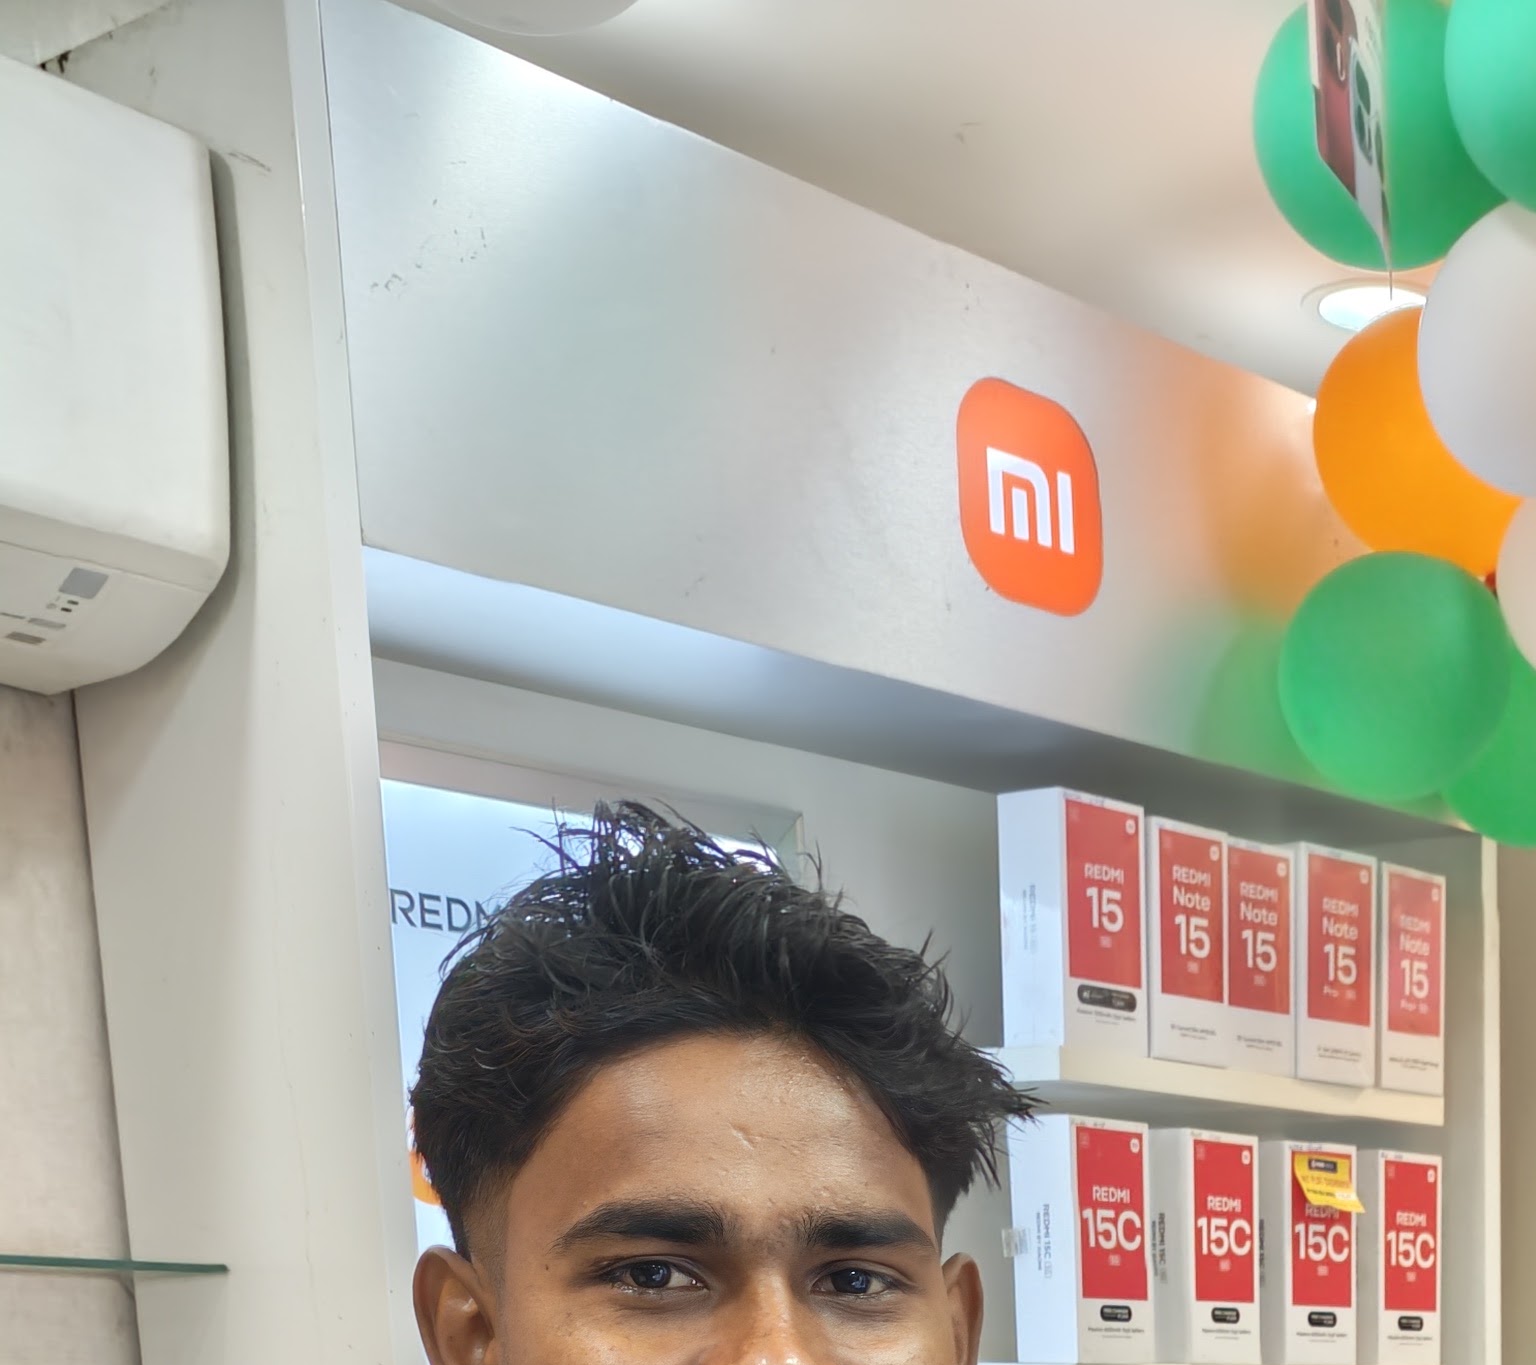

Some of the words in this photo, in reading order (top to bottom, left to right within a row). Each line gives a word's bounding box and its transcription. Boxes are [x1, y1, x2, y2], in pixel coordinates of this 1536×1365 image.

[1084, 862, 1125, 885] REDMI
[1172, 864, 1211, 887] REDMI
[1172, 885, 1212, 912] Note
[1240, 880, 1279, 902] REDMI
[1086, 886, 1125, 933] 15
[1240, 900, 1278, 927] Note
[1322, 896, 1360, 918] REDMI
[1174, 913, 1211, 959] 15
[1322, 916, 1359, 941] Note
[1241, 929, 1278, 972] 15
[1400, 934, 1431, 957] Note
[1323, 943, 1358, 985] 15
[1400, 959, 1430, 999] 15
[1092, 1184, 1131, 1204] REDMI
[1207, 1194, 1242, 1213] REDMI
[1305, 1202, 1340, 1219] REDMI
[1396, 1209, 1427, 1227] REDMI
[1082, 1207, 1142, 1252] 15C
[1197, 1216, 1252, 1257] 15C
[1295, 1222, 1350, 1263] 15C
[1387, 1229, 1436, 1269] 15C
